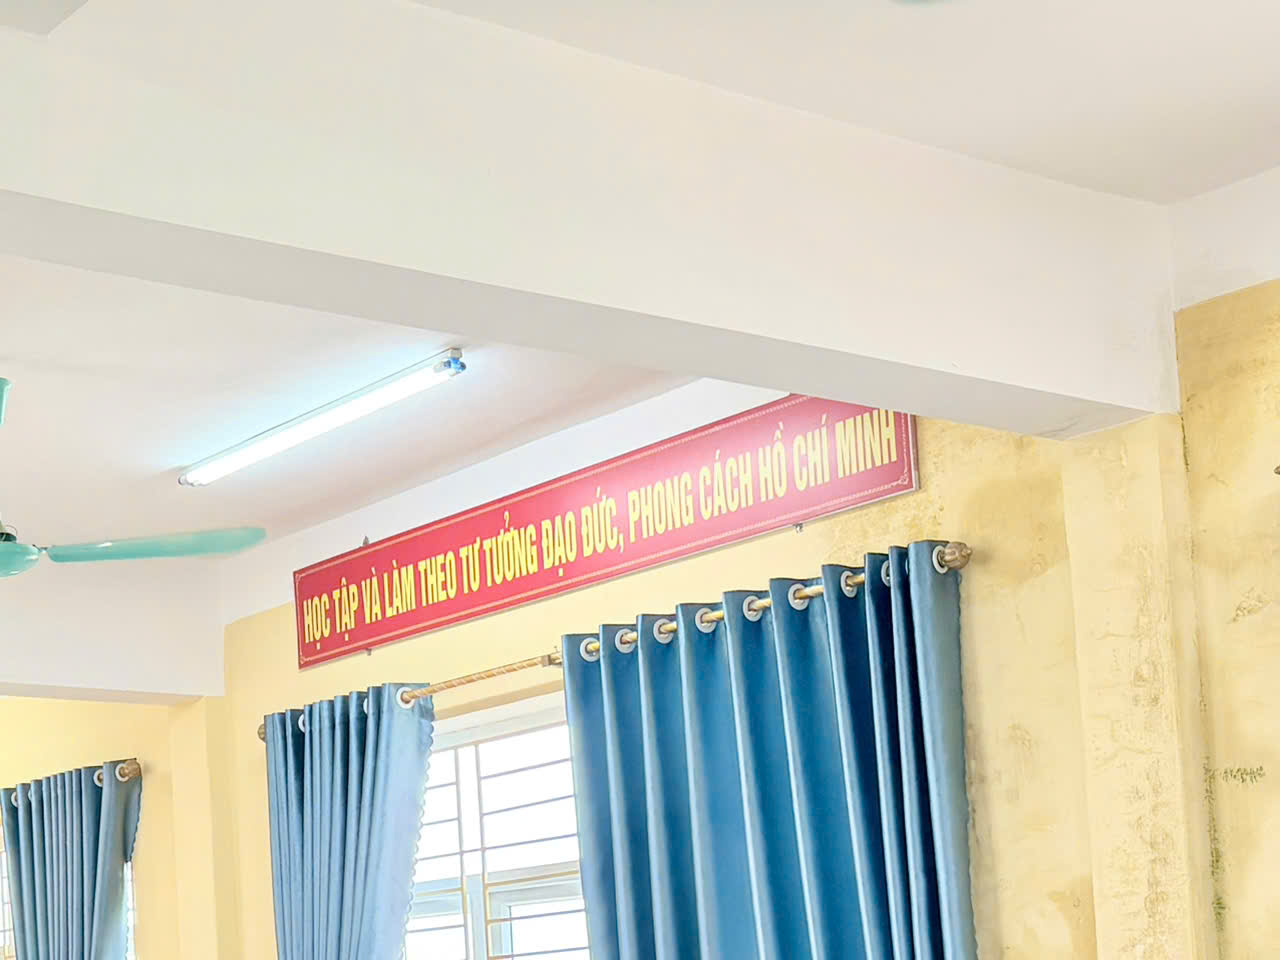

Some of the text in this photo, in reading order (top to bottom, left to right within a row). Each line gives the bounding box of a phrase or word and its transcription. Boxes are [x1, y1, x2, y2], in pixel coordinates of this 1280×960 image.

[303, 410, 897, 650] HỌC TẬP VÀ LÀM THEO TƯ TƯỞNG ĐẠO ĐỨC, PHONG CÁCH HỒ CHÍ MINH
